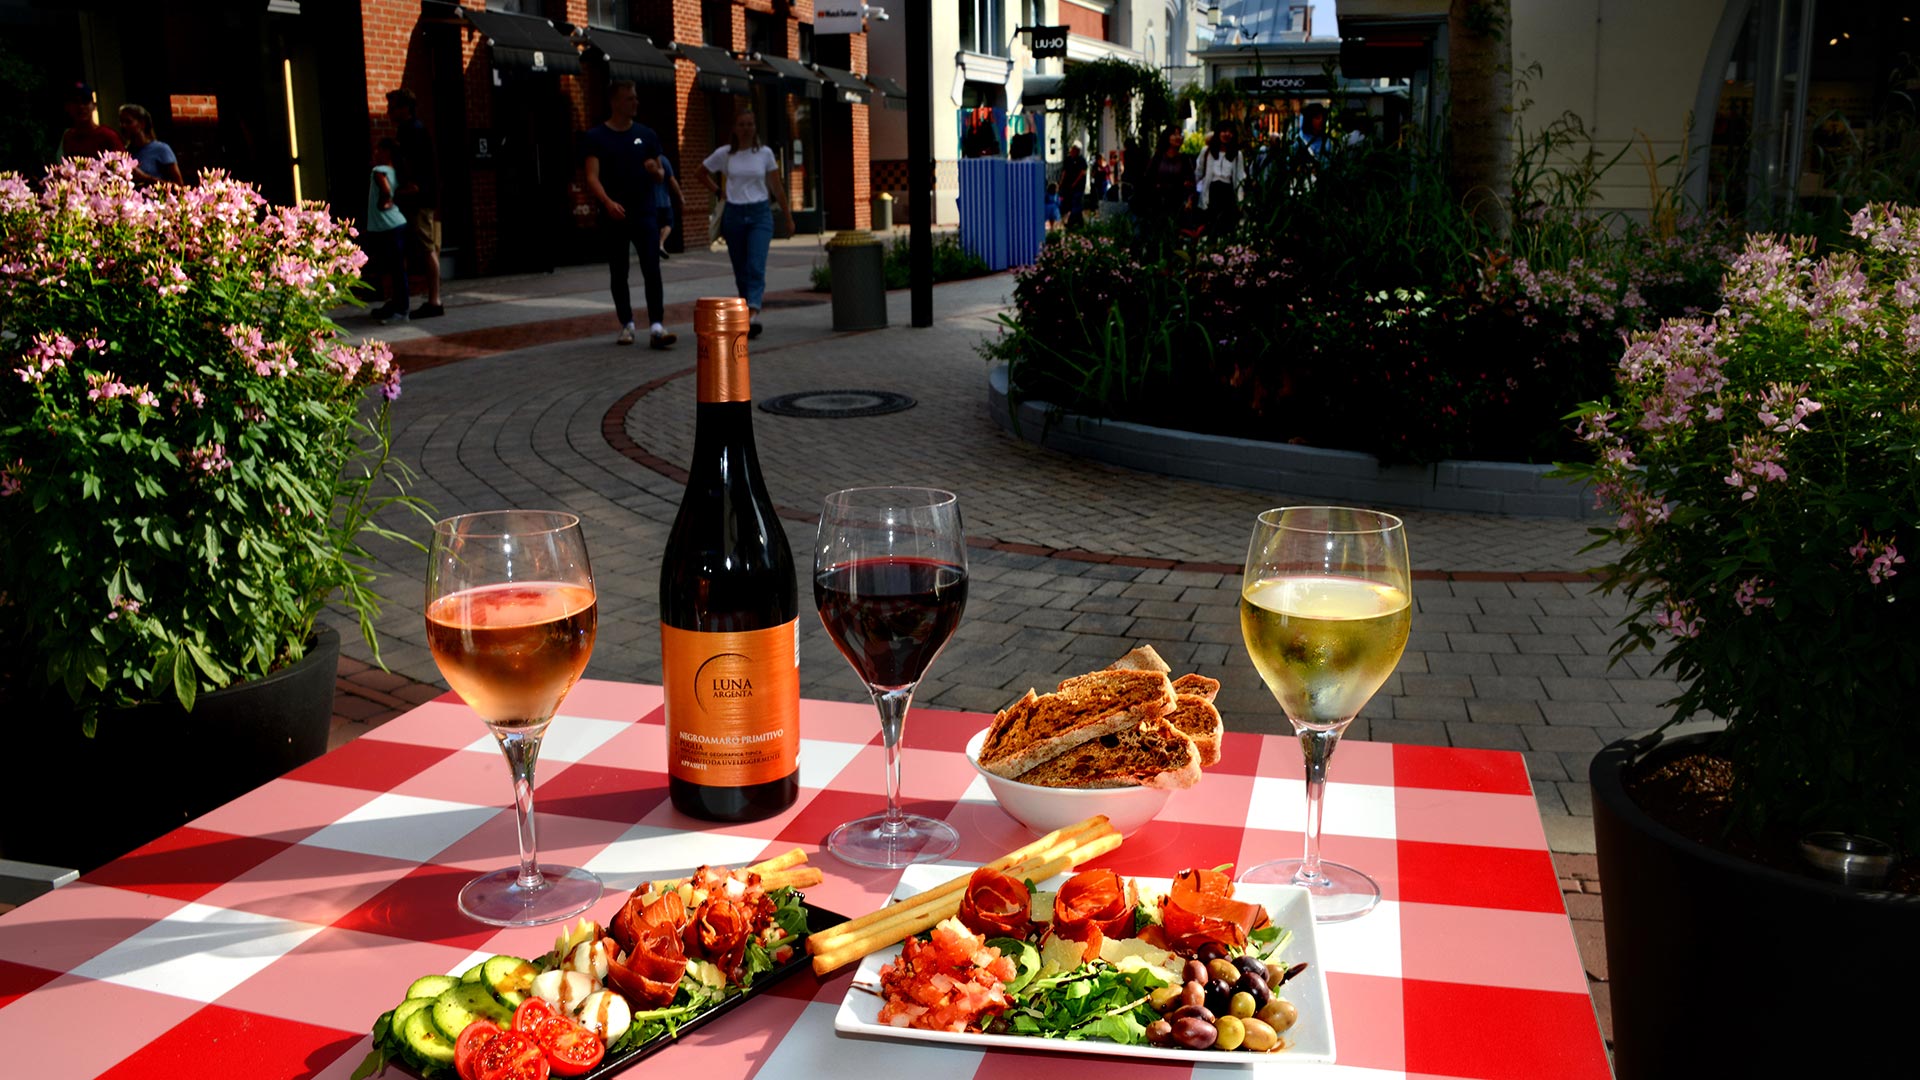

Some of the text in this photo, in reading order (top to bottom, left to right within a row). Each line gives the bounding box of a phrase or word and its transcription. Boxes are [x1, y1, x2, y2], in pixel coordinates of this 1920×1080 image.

[1261, 78, 1306, 88] KOMONO
[713, 678, 753, 691] LUNA
[679, 729, 784, 745] NEGROAMARO PRIMITIVO
[680, 740, 704, 751] PUGLIA
